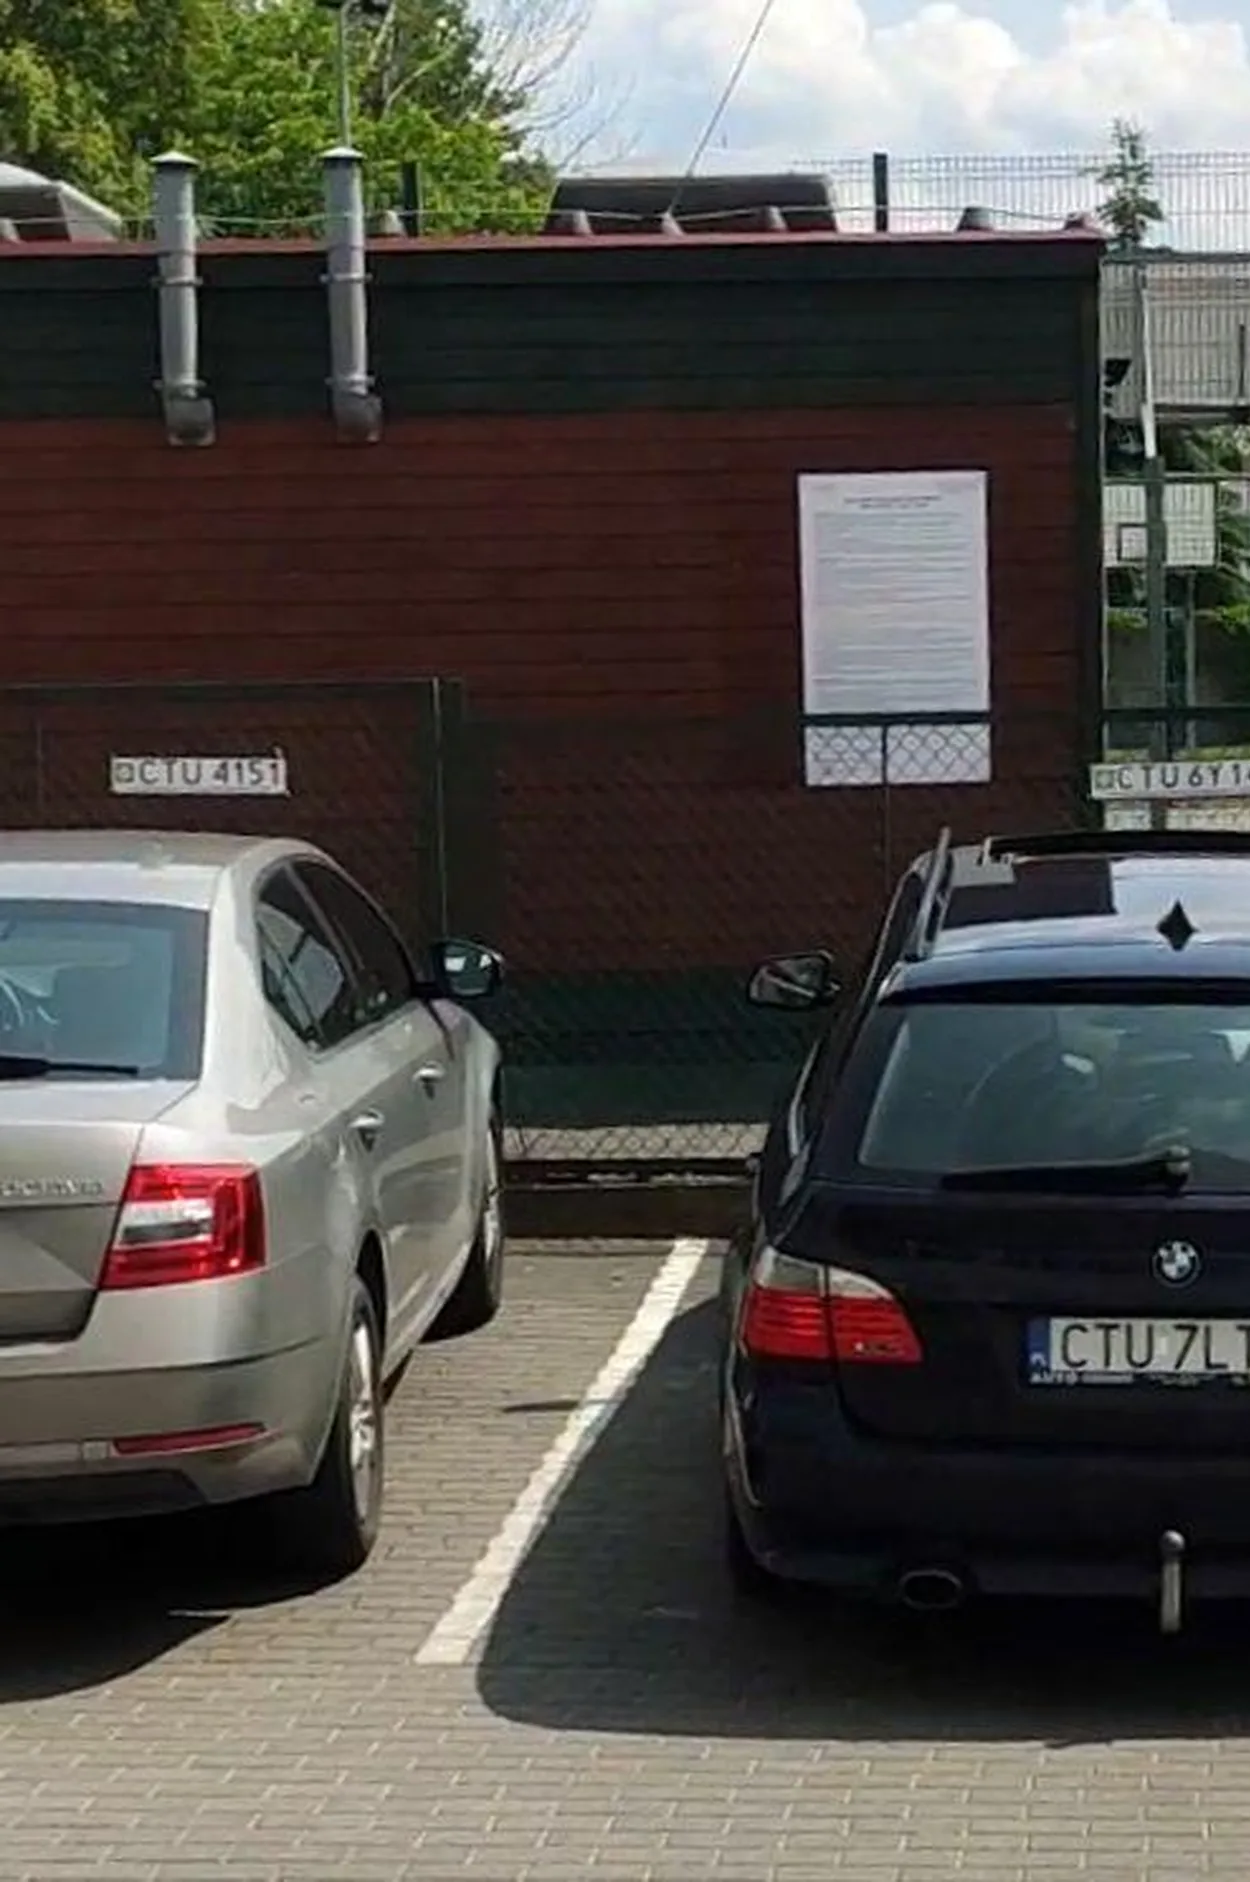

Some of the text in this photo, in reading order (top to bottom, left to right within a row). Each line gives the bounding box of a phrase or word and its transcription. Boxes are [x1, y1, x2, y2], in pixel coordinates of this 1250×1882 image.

[139, 758, 203, 785] CTU
[1117, 764, 1180, 789] CTU
[1061, 1323, 1154, 1369] CTU
